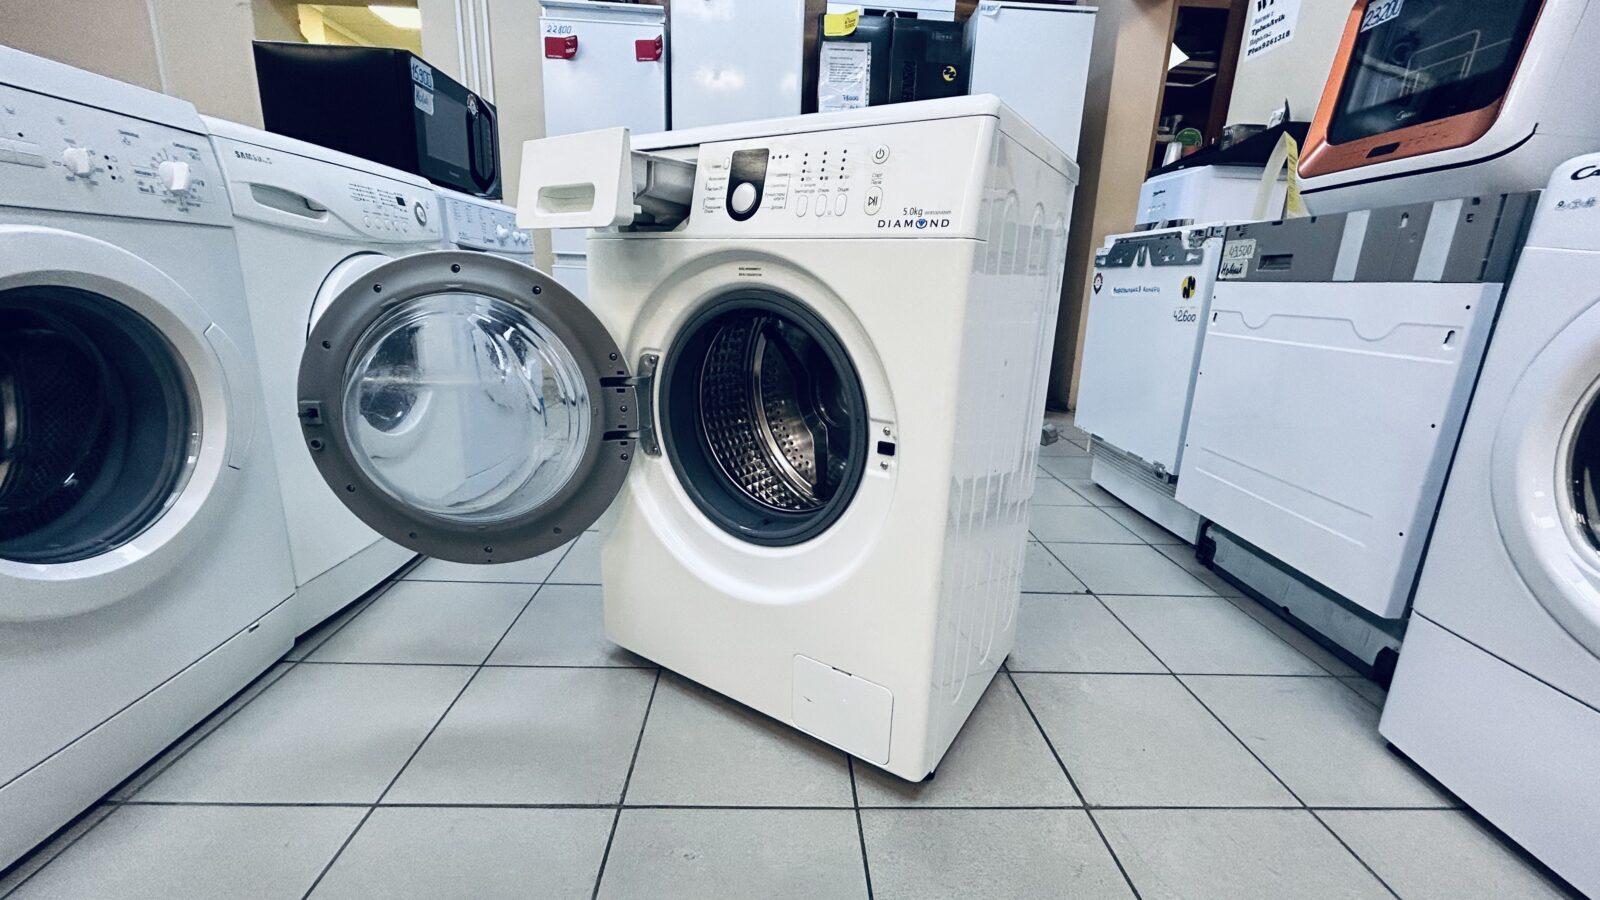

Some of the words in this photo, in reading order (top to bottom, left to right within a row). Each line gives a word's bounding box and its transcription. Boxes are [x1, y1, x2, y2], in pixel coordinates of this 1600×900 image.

[903, 206, 923, 218] 5.0kg
[877, 218, 950, 230] DIAMOND
[1173, 310, 1196, 322] 42600
